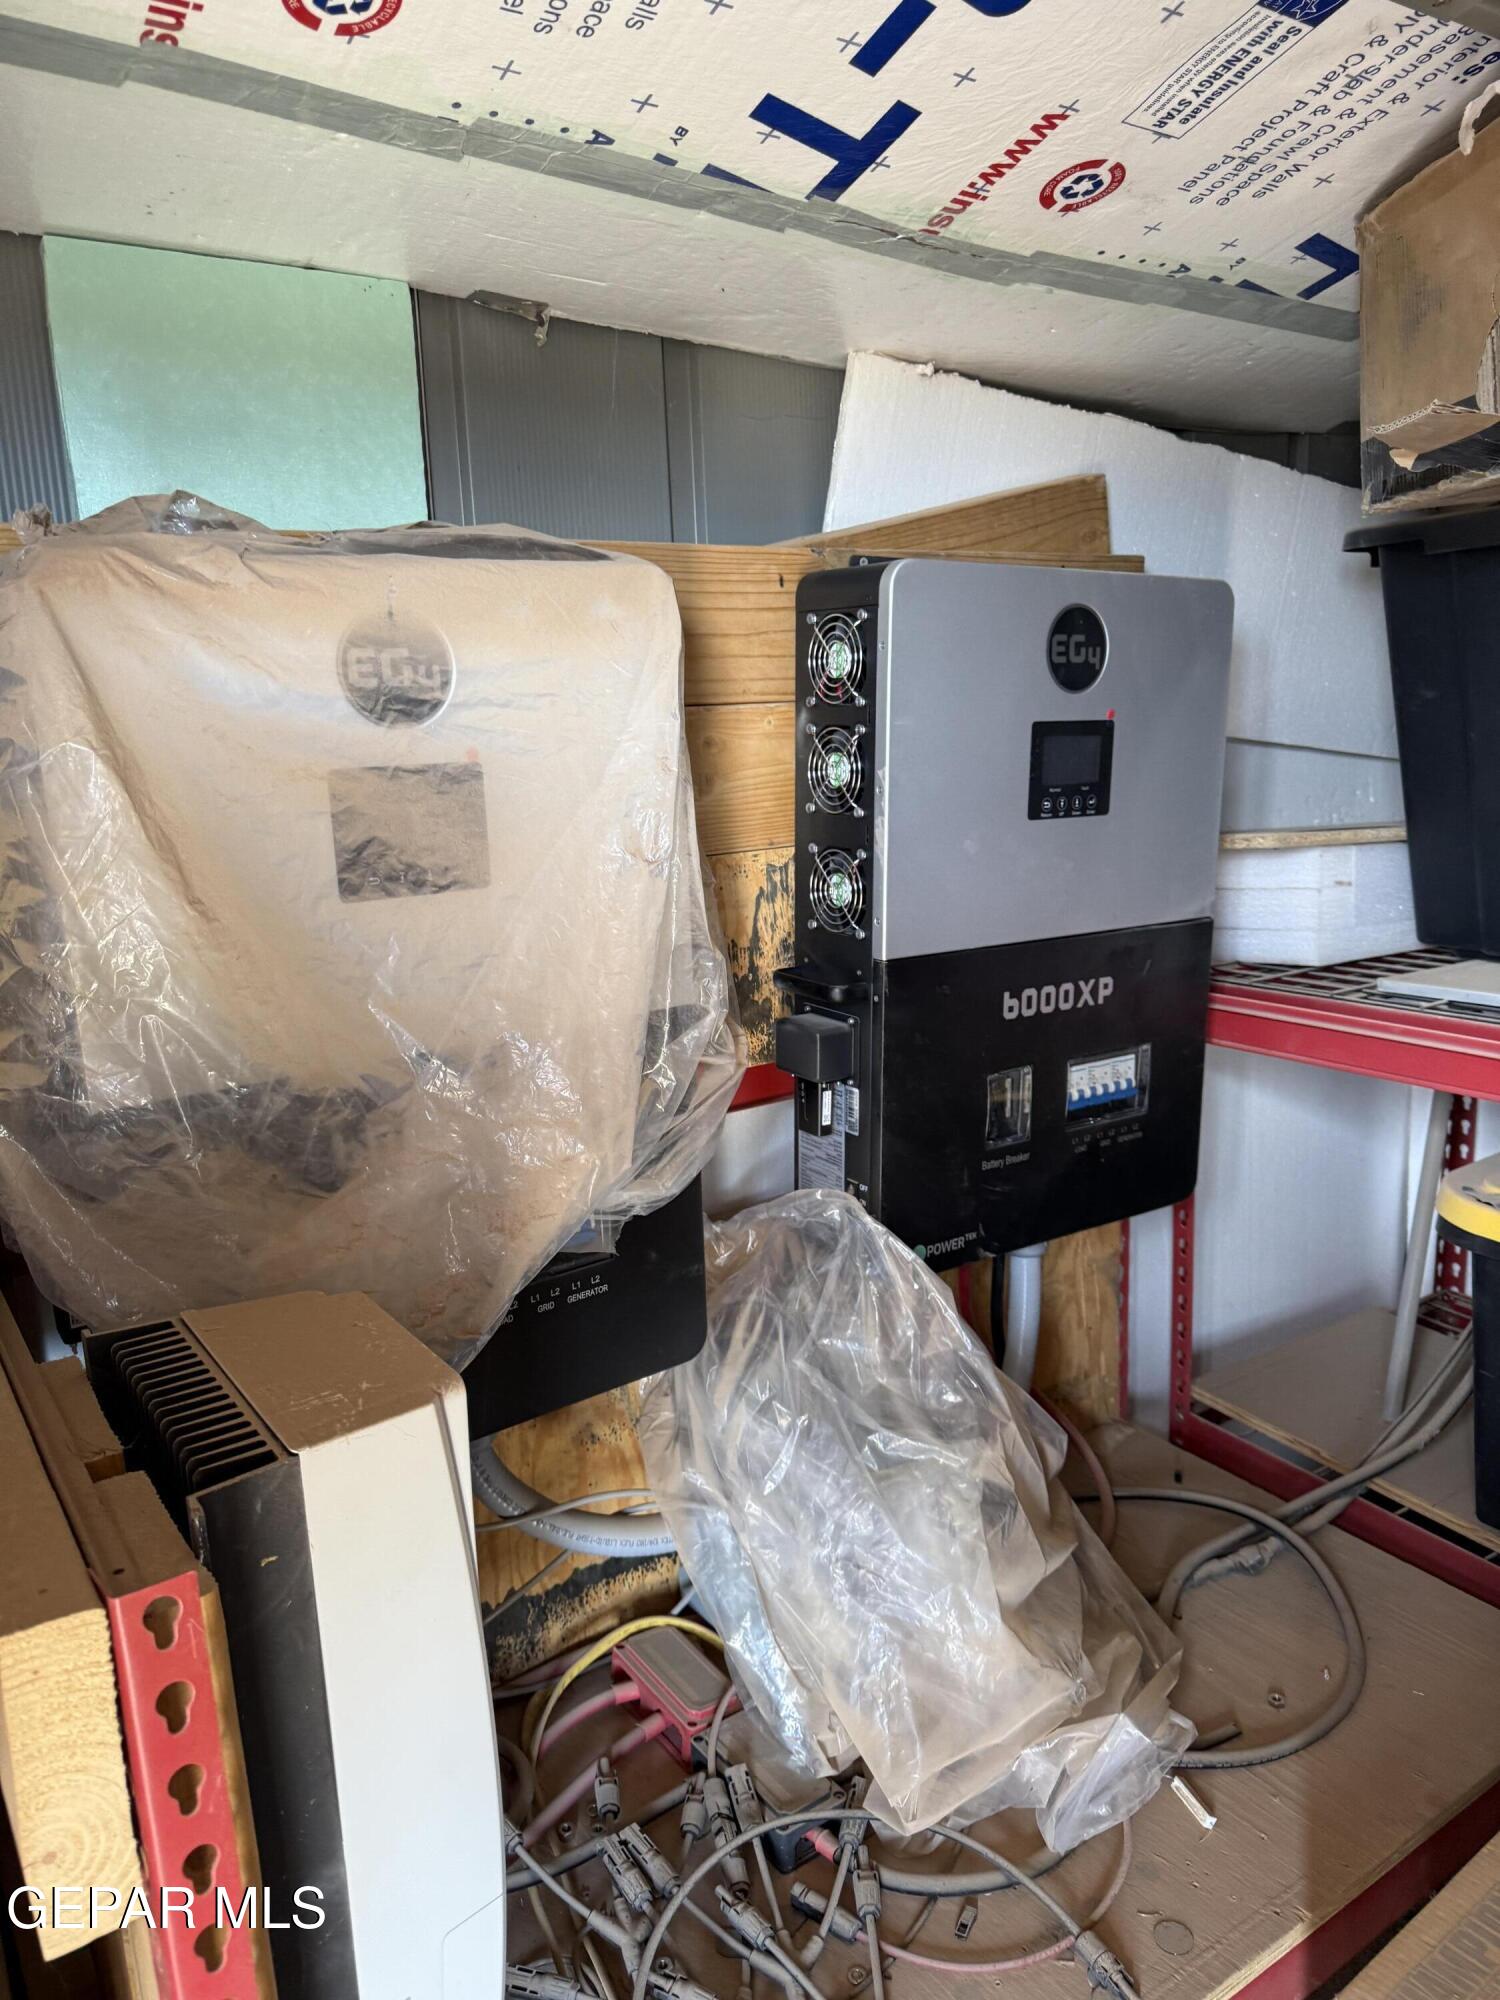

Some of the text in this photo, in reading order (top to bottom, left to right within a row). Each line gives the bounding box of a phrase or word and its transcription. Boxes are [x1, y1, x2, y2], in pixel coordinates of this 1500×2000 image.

[1364, 34, 1388, 48] &
[1152, 20, 1284, 129] with ENERGY STAR
[1179, 26, 1302, 125] Seal and Insulate
[1304, 53, 1365, 98] Craft
[1309, 104, 1331, 117] &
[1334, 107, 1357, 119] &
[1387, 92, 1410, 105] &
[669, 125, 689, 147] BY
[1232, 100, 1309, 152] Project
[1277, 123, 1336, 161] Crawl
[1311, 108, 1389, 162] Exterior
[1177, 154, 1236, 193] Panel
[1189, 120, 1312, 205] Foundations
[1252, 163, 1308, 199] Walls
[1216, 163, 1277, 206] Space
[1051, 634, 1100, 670] EG4
[1003, 976, 1114, 1020] 6000XP
[981, 1151, 1031, 1171] Battery Breaker
[530, 1293, 540, 1304] L1
[550, 1287, 561, 1297] L2
[571, 1281, 581, 1291] L1
[590, 1274, 601, 1285] L2
[537, 1300, 555, 1313] GRID
[567, 1284, 609, 1304] GENERATOR
